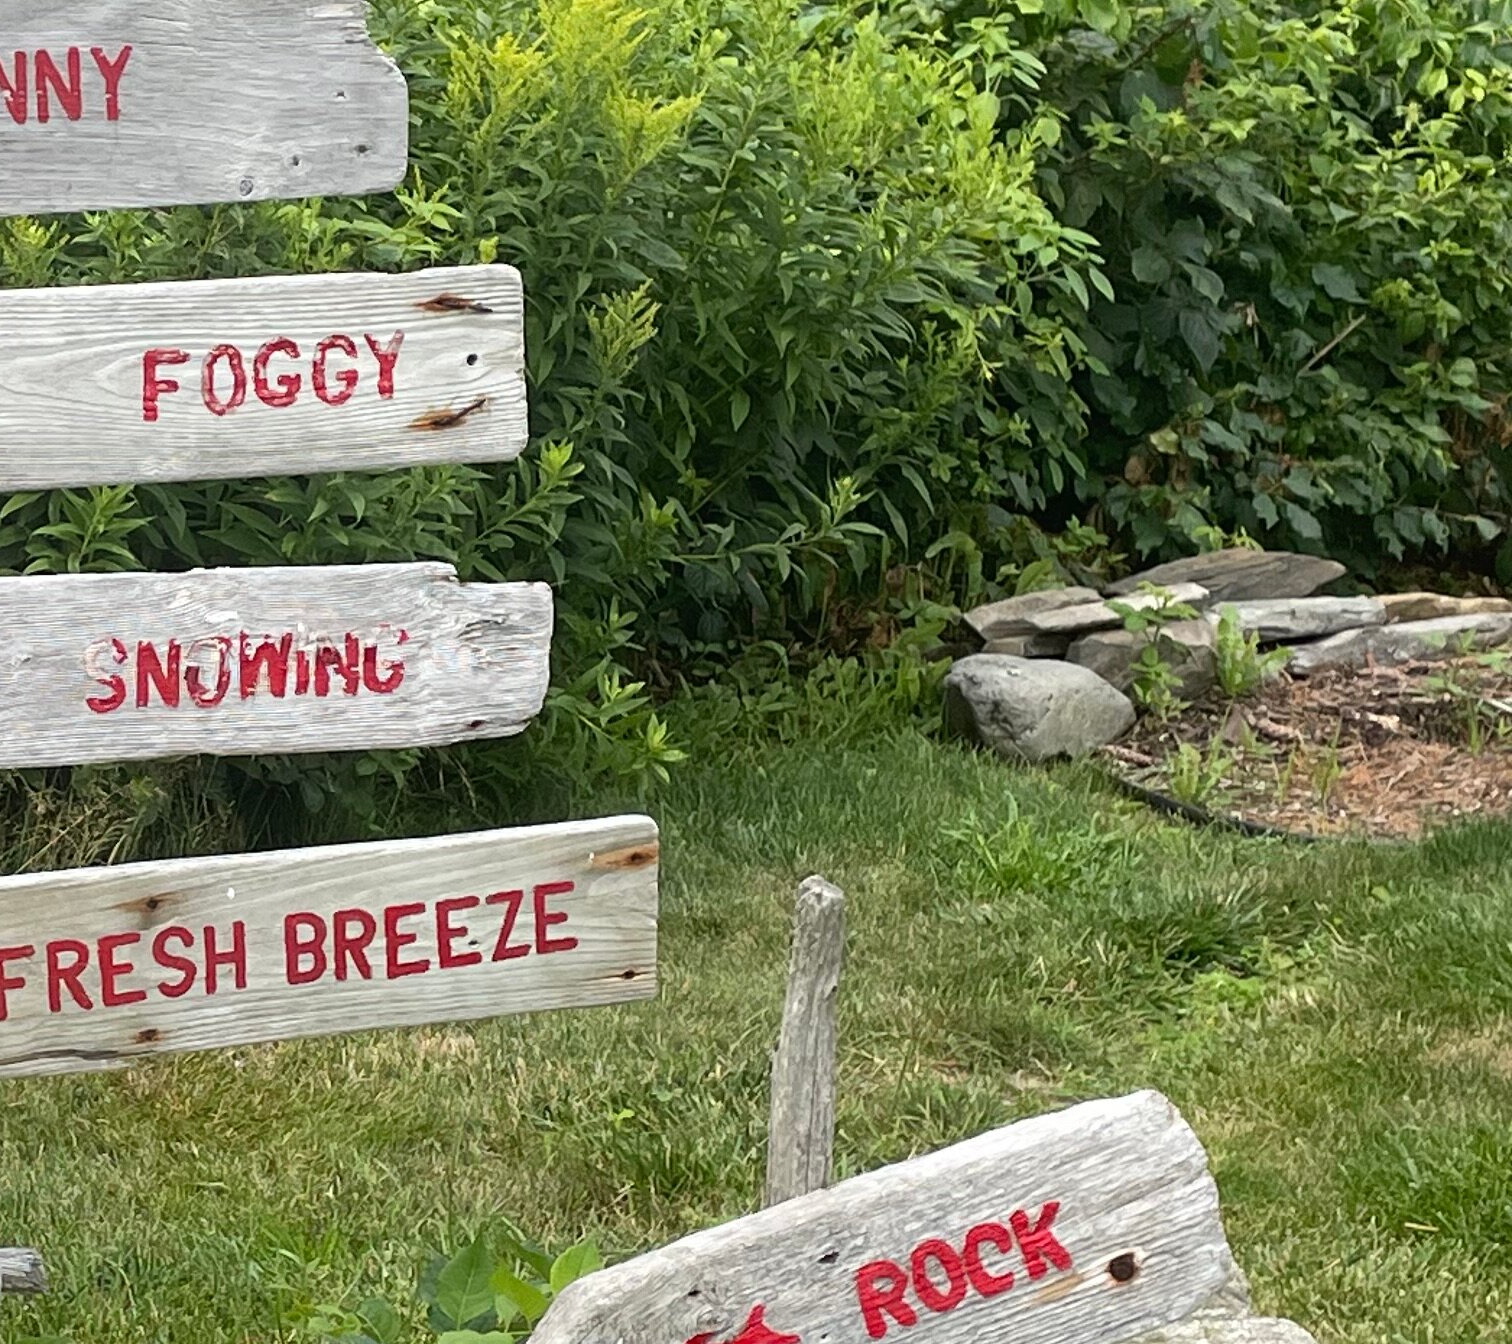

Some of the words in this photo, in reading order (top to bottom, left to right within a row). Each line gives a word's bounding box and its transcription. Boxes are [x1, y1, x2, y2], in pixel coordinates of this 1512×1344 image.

[142, 329, 405, 422] FOGGY
[83, 623, 411, 714] SNOWING
[283, 879, 579, 985] BREEZE
[854, 1200, 1073, 1340] ROCK
